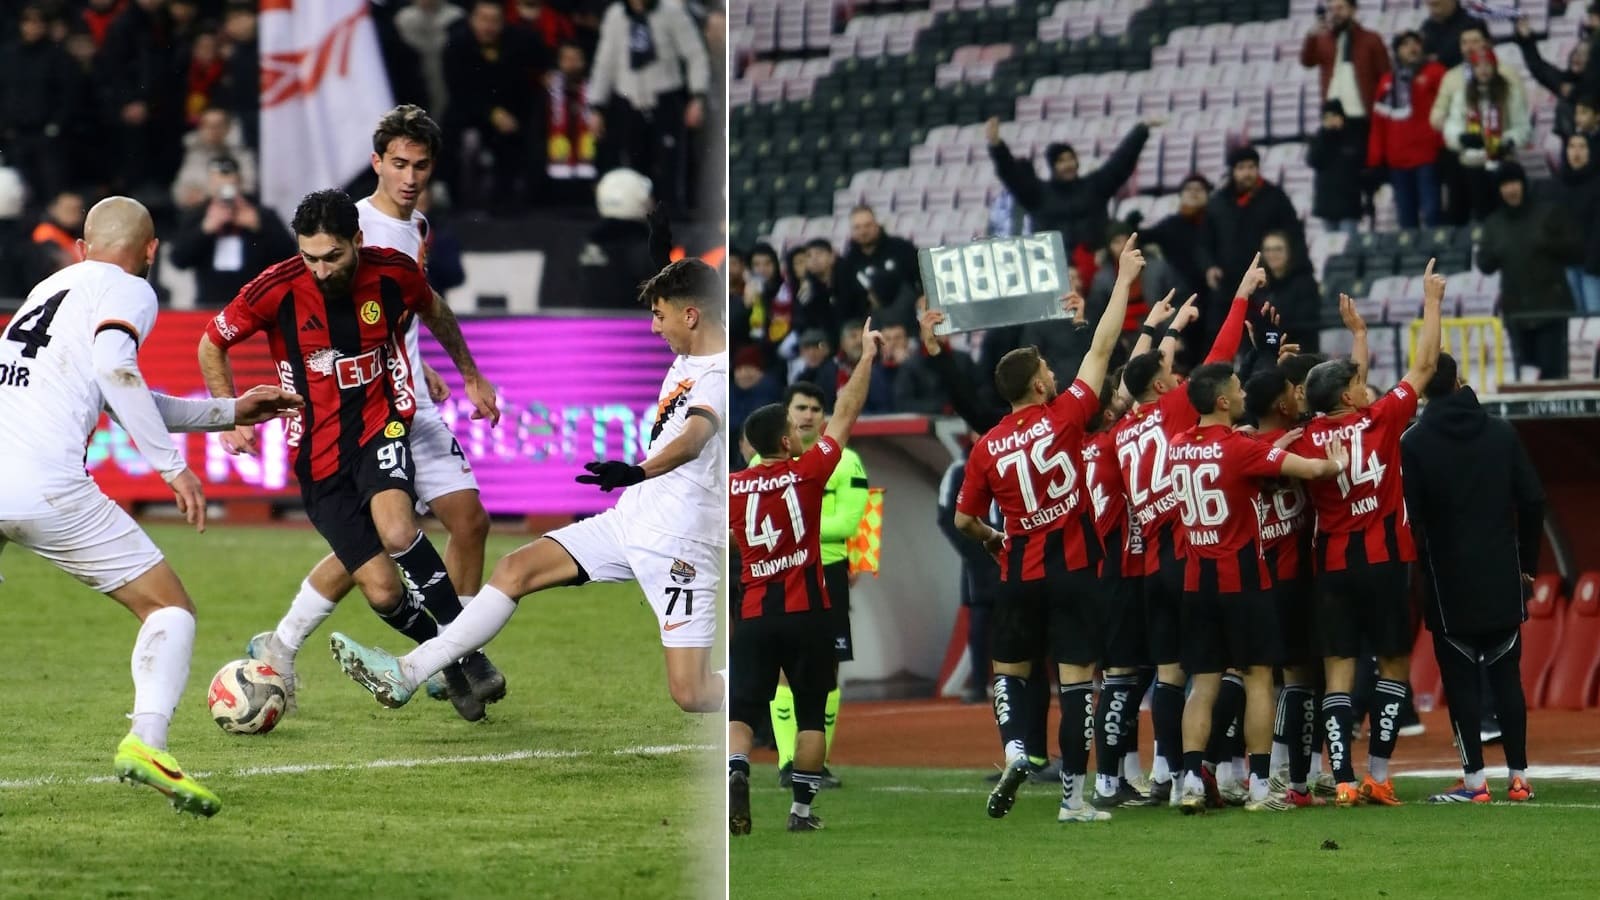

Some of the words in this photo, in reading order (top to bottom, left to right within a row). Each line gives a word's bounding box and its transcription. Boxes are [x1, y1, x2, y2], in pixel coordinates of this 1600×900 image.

[7, 289, 71, 359] 4
[987, 417, 1053, 456] turknet
[1168, 441, 1224, 462] turknet
[731, 470, 803, 495] turknet
[996, 433, 1078, 514] 75
[1117, 425, 1173, 507] 22
[1171, 463, 1230, 527] 96
[1351, 496, 1379, 516] AKIN
[745, 483, 806, 553] 41
[1189, 530, 1220, 546] KAAN
[750, 548, 809, 578] BÜNYAMİN
[664, 586, 694, 616] 71
